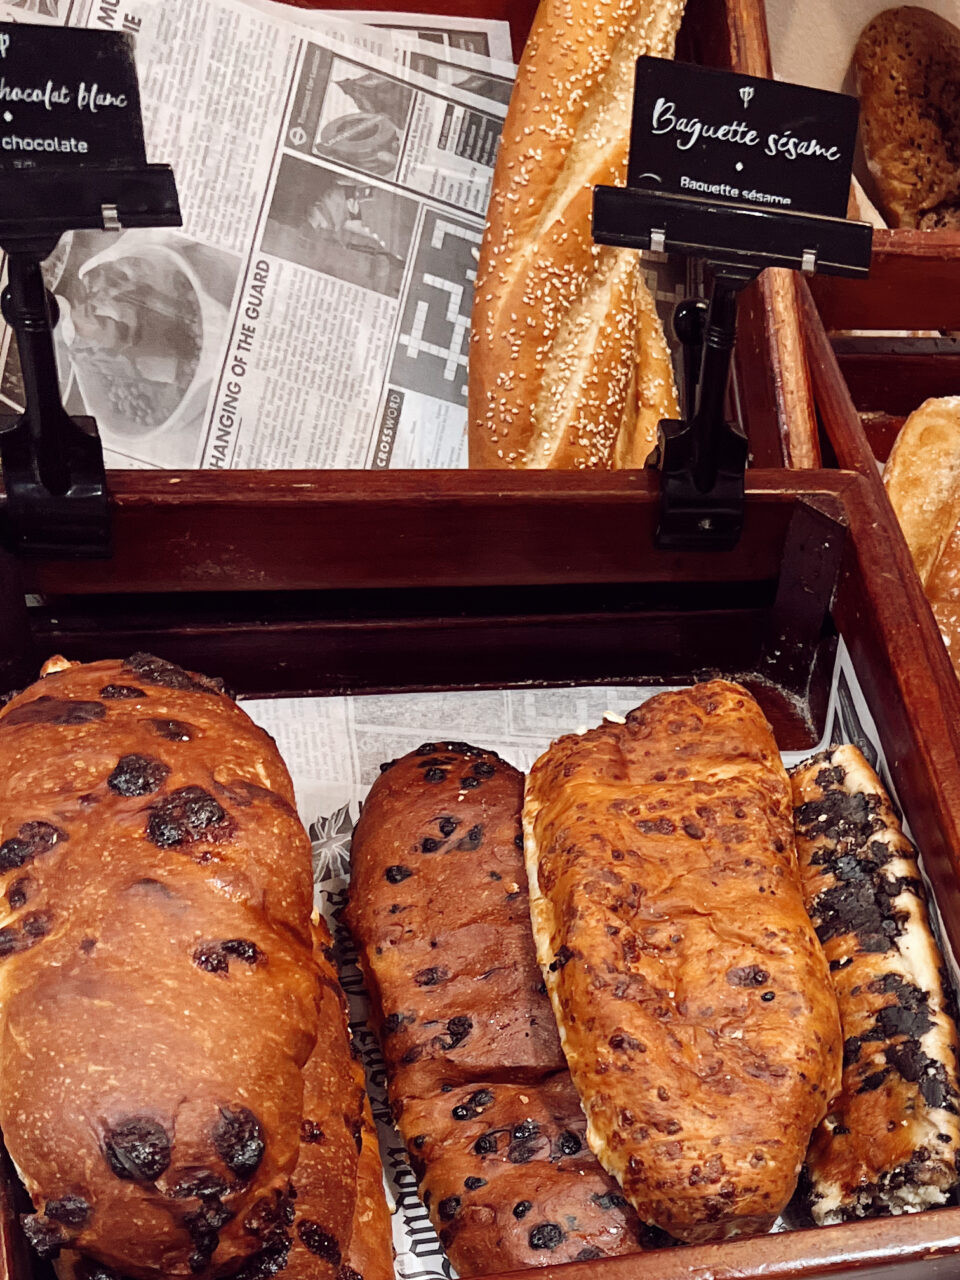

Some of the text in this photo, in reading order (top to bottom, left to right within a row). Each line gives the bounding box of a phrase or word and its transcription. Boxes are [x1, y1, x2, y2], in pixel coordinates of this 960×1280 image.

[0, 77, 128, 112] hocolat blanc
[2, 134, 88, 153] chocolate
[651, 98, 841, 161] Baguette sésame
[680, 176, 792, 205] Baguette sésame
[245, 259, 270, 321] GUARD
[237, 324, 256, 353] THE
[231, 355, 248, 377] OF
[206, 381, 242, 469] HANGING
[376, 394, 400, 467] CROSSWORD
